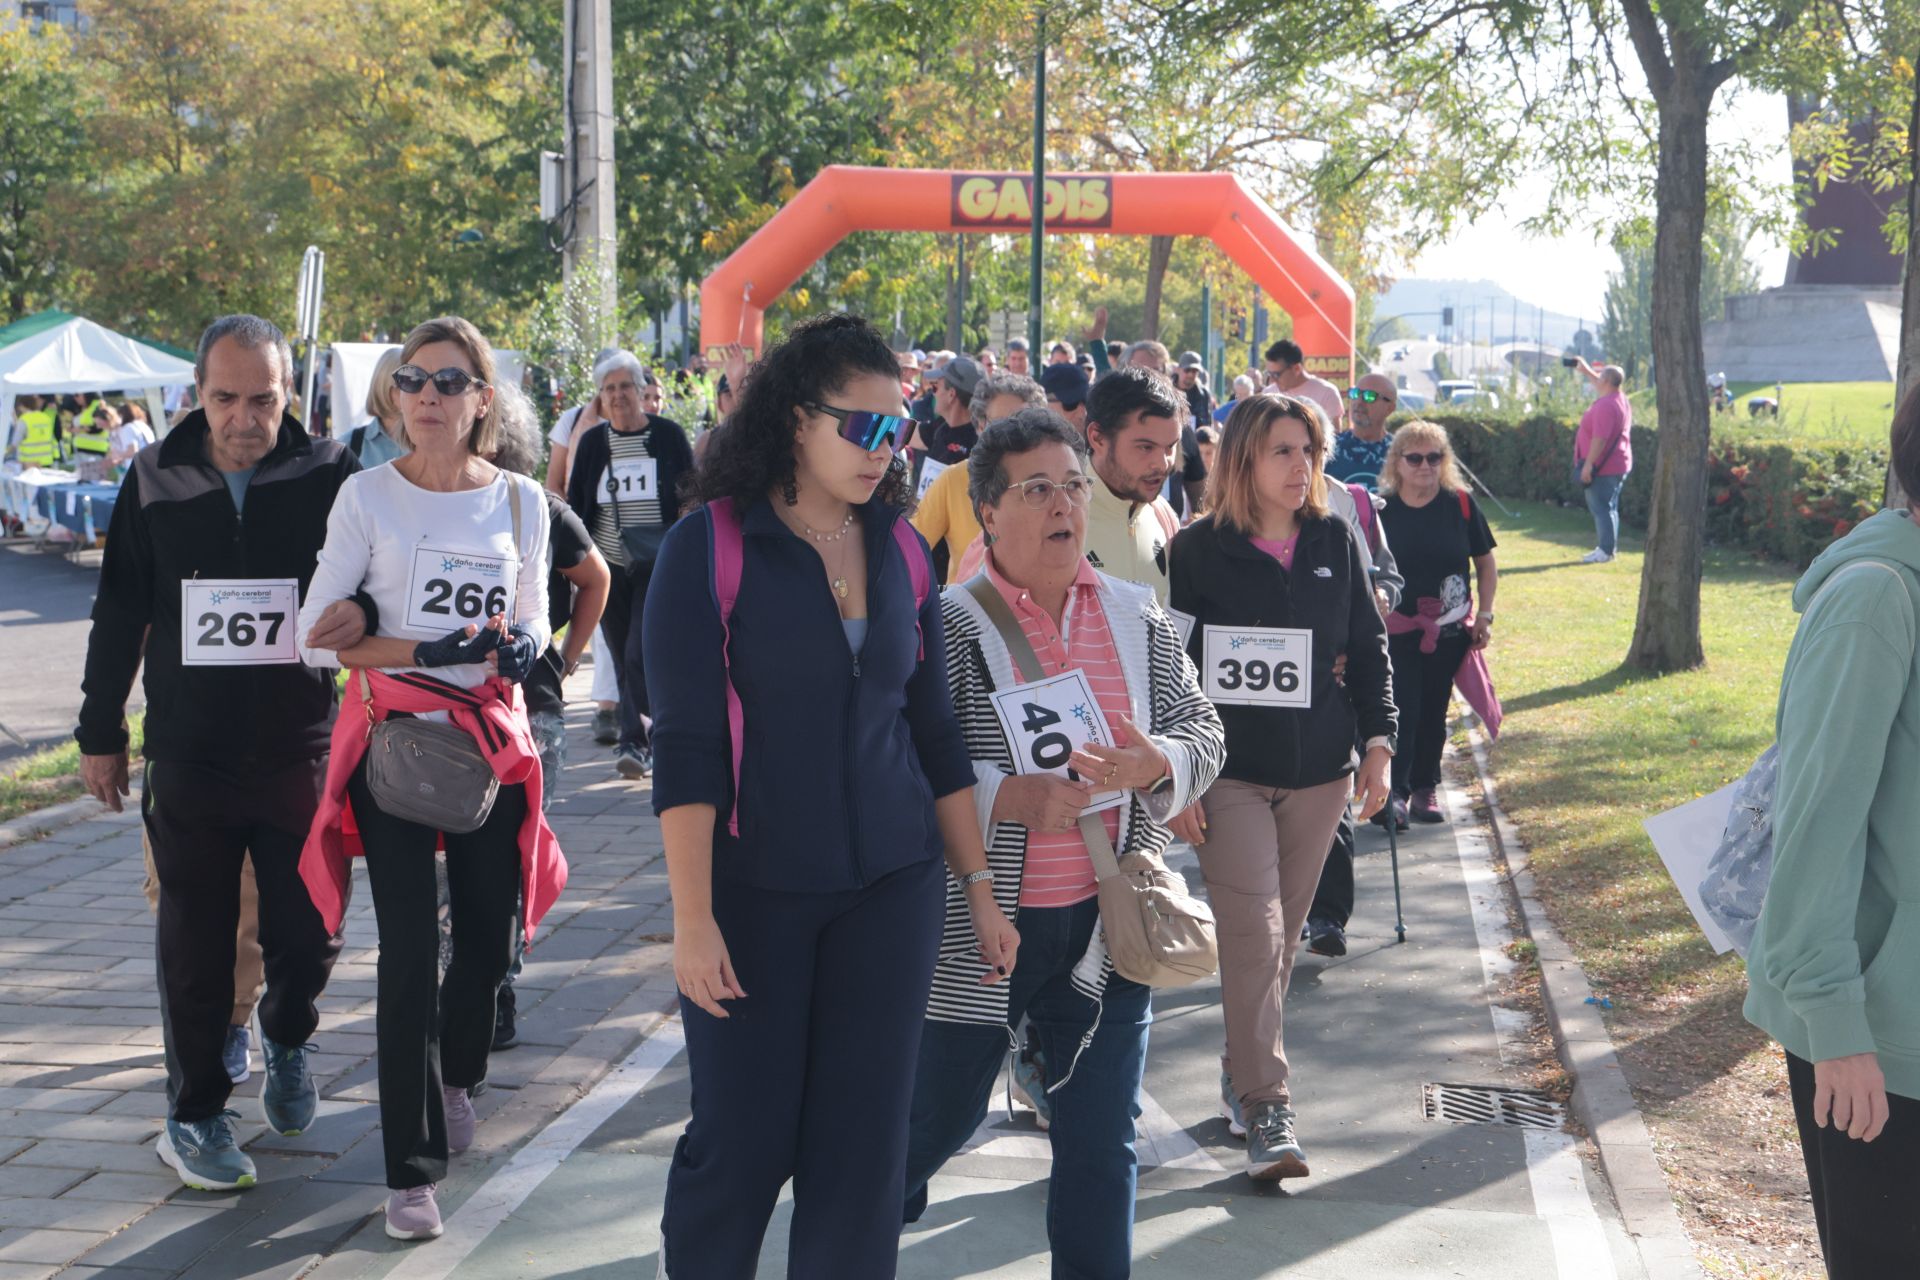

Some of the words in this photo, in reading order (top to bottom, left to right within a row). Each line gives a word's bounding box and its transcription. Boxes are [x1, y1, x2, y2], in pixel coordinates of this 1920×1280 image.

[959, 178, 1109, 220] GADIS
[454, 559, 473, 567] daño
[475, 562, 501, 570] cerebral
[421, 579, 507, 618] 266
[197, 612, 285, 647] 267
[1217, 658, 1299, 692] 396
[1022, 702, 1080, 781] 40
[1085, 714, 1097, 736] daño
